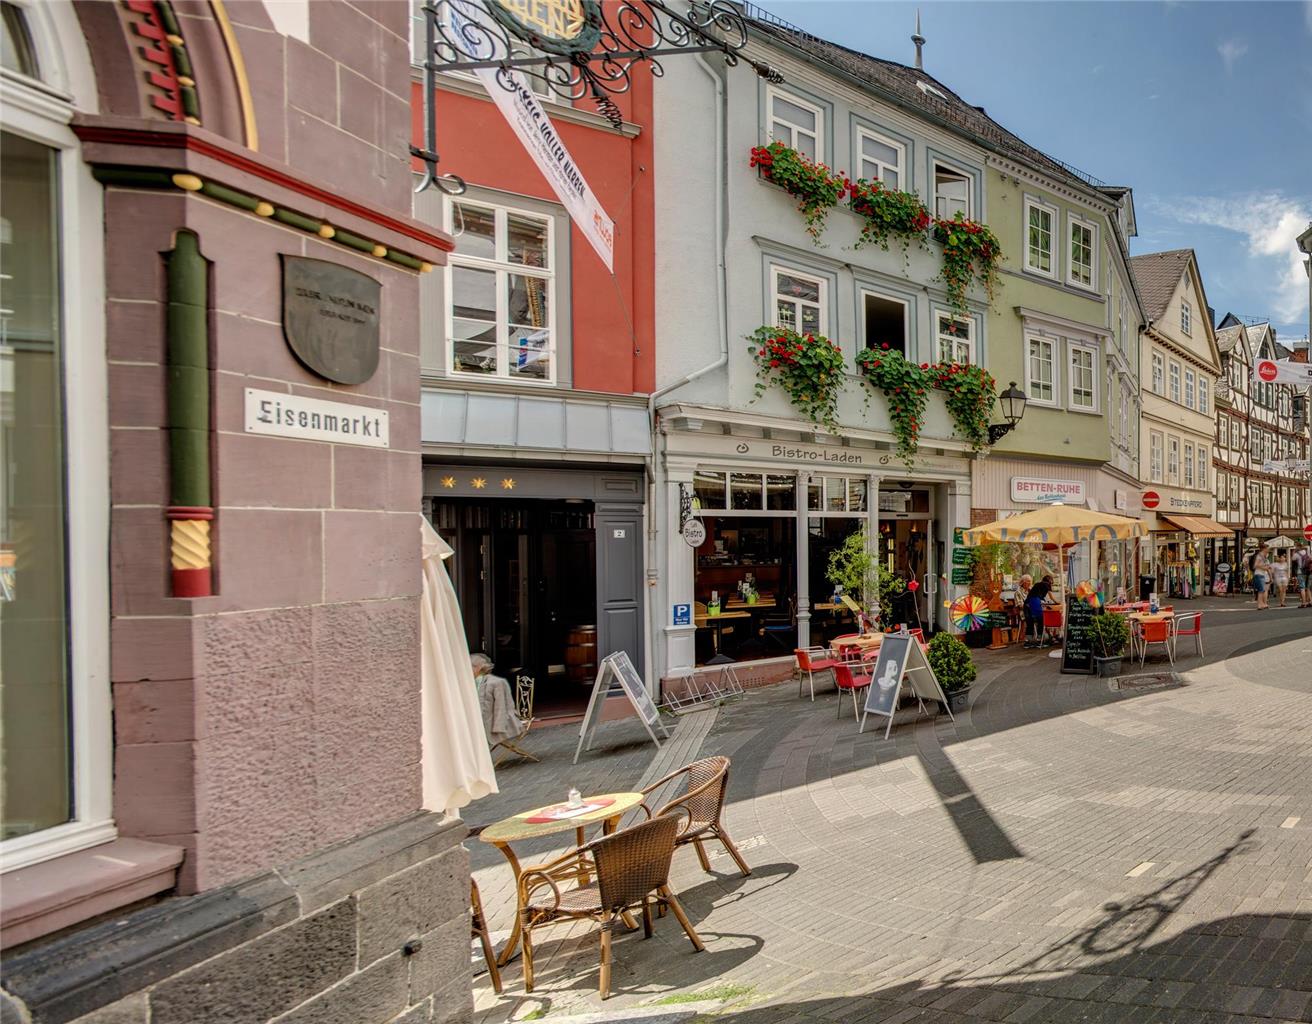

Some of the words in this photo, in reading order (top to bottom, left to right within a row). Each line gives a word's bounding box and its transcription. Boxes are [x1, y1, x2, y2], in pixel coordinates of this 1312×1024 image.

[257, 400, 381, 438] Eisenmarkt
[772, 445, 863, 464] Bistro-Laden
[1016, 481, 1081, 495] BETTEN-RUHE
[684, 527, 703, 539] Bistro
